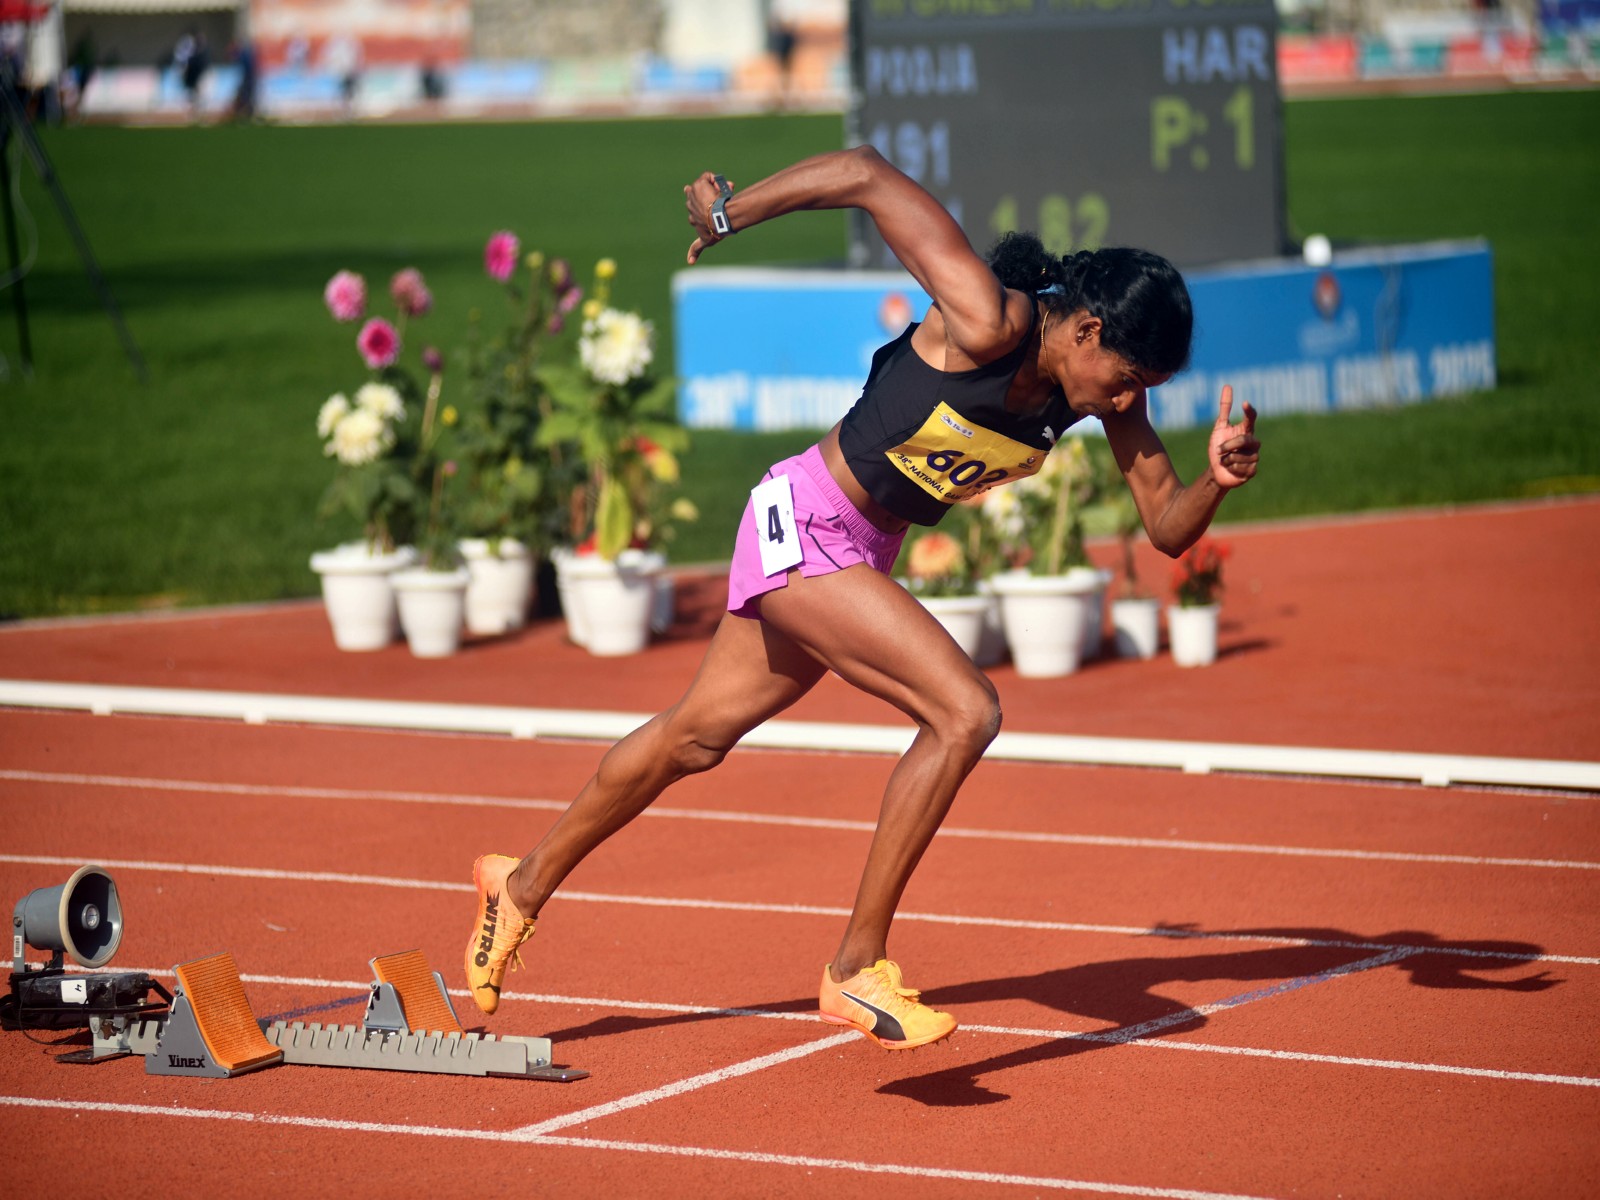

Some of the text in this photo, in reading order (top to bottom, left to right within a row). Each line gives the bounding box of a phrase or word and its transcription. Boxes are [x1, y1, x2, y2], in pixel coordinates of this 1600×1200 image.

[1162, 26, 1269, 84] HAR
[1152, 95, 1209, 171] P:
[1224, 86, 1254, 170] 1
[909, 465, 945, 494] NATIONAL
[767, 504, 785, 544] 4
[475, 889, 500, 968] NITRO
[168, 1054, 206, 1068] Vinex
